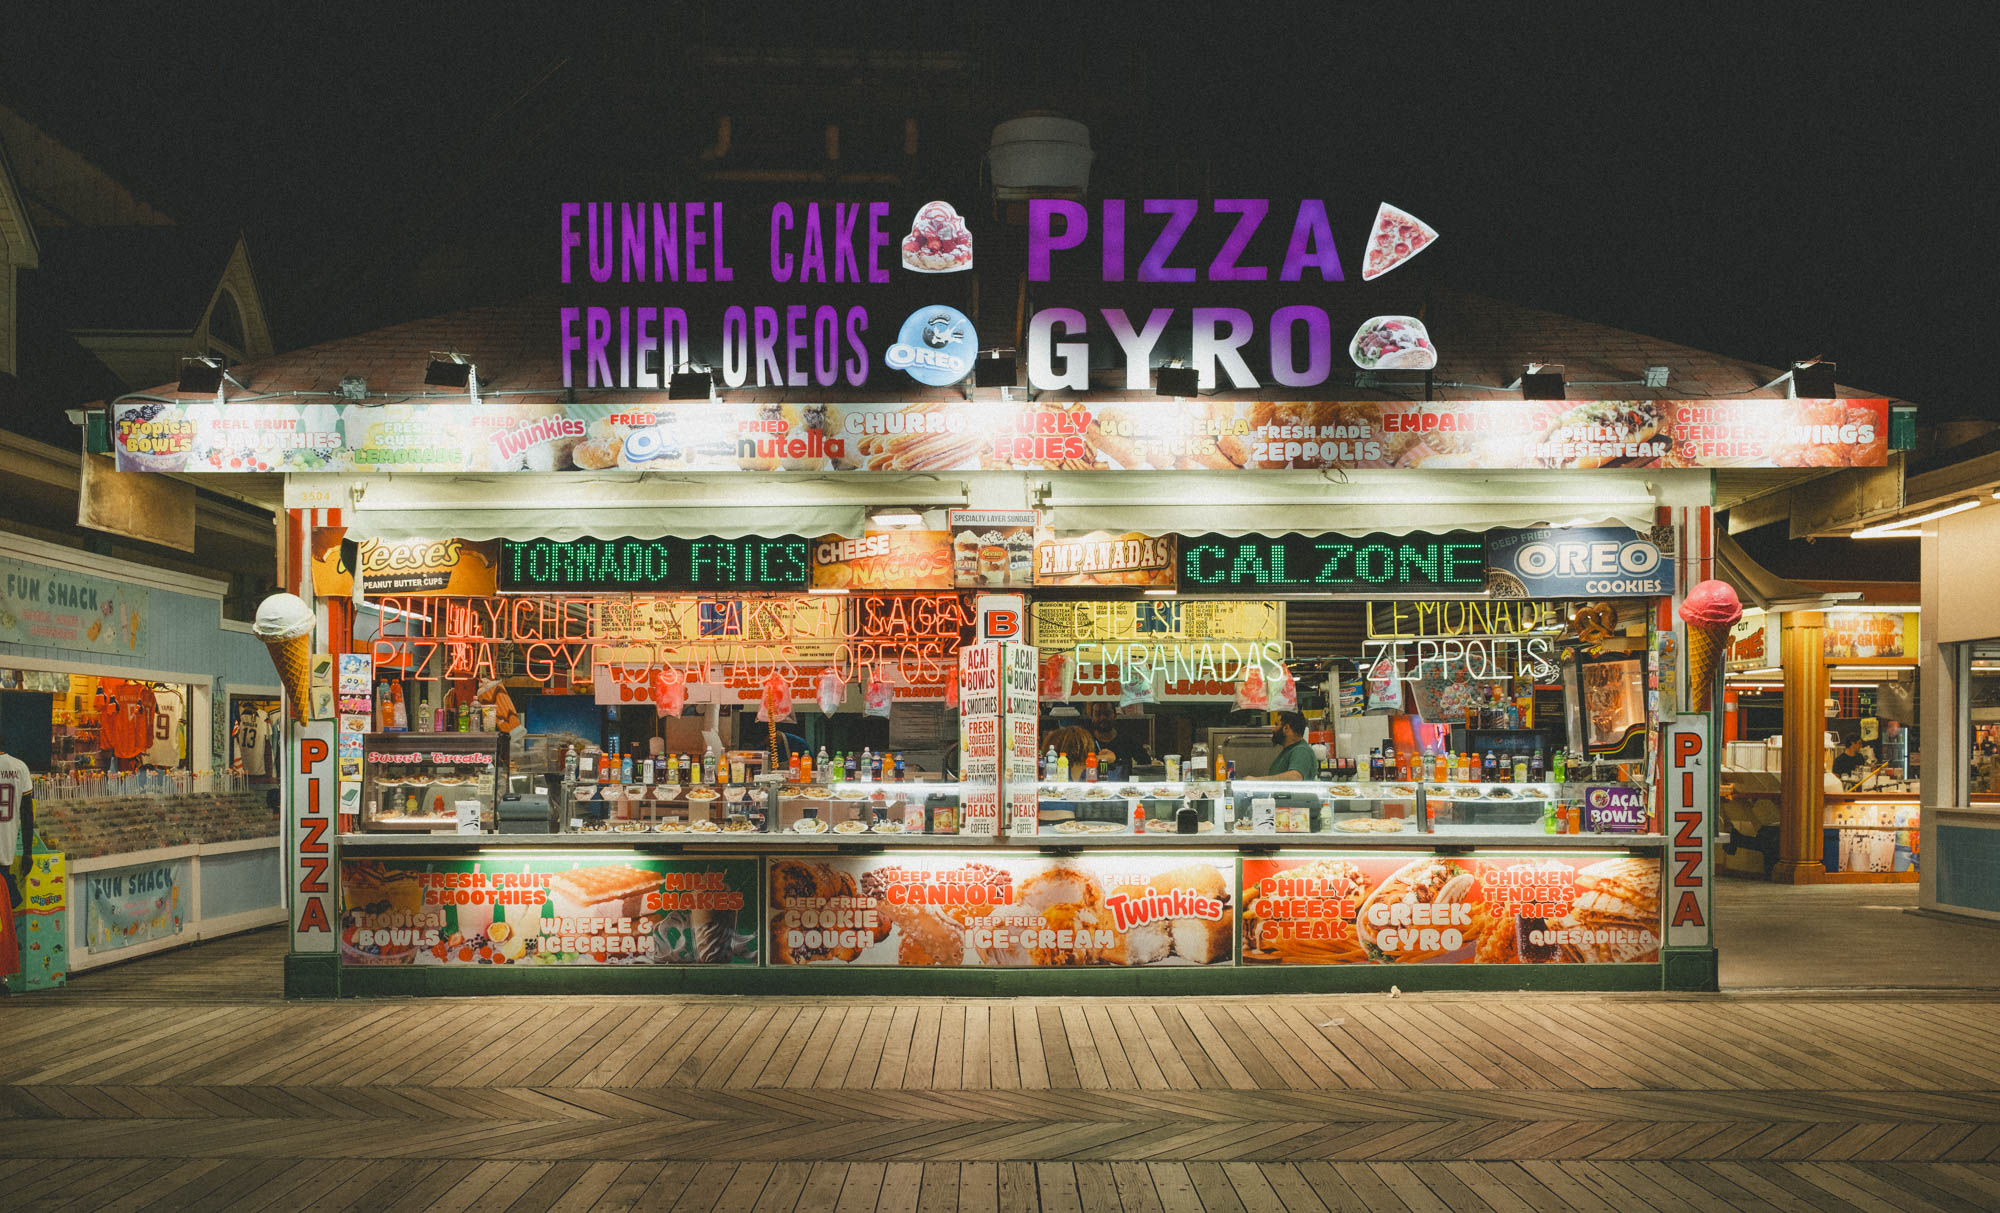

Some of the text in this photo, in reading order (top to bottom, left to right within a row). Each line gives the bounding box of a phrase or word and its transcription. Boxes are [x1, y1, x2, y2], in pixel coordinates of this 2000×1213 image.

[560, 201, 890, 283] FUNNEL CAKE
[1028, 199, 1345, 283] PIZZA
[560, 305, 869, 388] FRIED OREOS
[1027, 305, 1331, 391] GYRO
[885, 344, 966, 374] OREO
[119, 420, 197, 438] Tropical
[212, 420, 297, 430] REAL FRUIT
[472, 416, 515, 427] FRIED
[610, 414, 657, 425] FRIED
[738, 420, 789, 432] FRIED
[1383, 413, 1548, 433] EMPANAAS
[490, 415, 585, 460] Twinkies
[1256, 425, 1372, 438] FRESH MADE
[1561, 425, 1628, 441] PHILLY
[126, 438, 192, 452] BOWLS
[738, 429, 845, 458] nutella
[993, 437, 1086, 459] FRIES
[1252, 442, 1382, 461] ZEPPOLIS
[1682, 442, 1764, 458] & FRIES
[954, 514, 985, 523] SPECIALTY
[816, 534, 890, 565] CHEESE
[1490, 530, 1552, 551] DEEP FRIED
[505, 543, 806, 582] TORNADO FRIES
[1039, 537, 1169, 575] EMPANADAS
[1186, 544, 1483, 583] CALZONE
[1514, 540, 1662, 577] OREO
[852, 551, 951, 585] NACHOS
[7, 574, 98, 611] FUN SHACK
[363, 576, 443, 589] PEANUT BUTTER CUPS
[1585, 579, 1662, 594] COOKIES
[1369, 601, 1562, 637] LEMONADE
[1737, 622, 1748, 631] CUT
[373, 641, 496, 681] PIZZA
[527, 642, 651, 684] GYRO
[967, 648, 989, 669] ACAI
[1014, 649, 1033, 671] ACAI
[967, 669, 996, 691] BOWLS
[1014, 670, 1036, 693] BOWLS
[967, 696, 997, 716] SMOOTHIES
[968, 721, 994, 734] FRESH
[1014, 721, 1035, 735] FRESH
[241, 727, 257, 749] 13
[968, 734, 996, 746] SQUEEZED
[367, 752, 493, 764] Sweet Treats
[968, 745, 996, 758] LEMONADE
[967, 804, 996, 818] DEALS
[1013, 804, 1036, 818] DEALS
[1590, 810, 1646, 823] BOWLS
[297, 738, 332, 932] PIZZA
[970, 823, 990, 834] COFFEE
[1671, 732, 1705, 927] PIZZA
[94, 867, 173, 900] FUN SHACK
[418, 872, 552, 888] FRESH FRUIT
[665, 872, 724, 891] MILK
[888, 870, 984, 883] DEEP FRIED
[1103, 874, 1151, 886] FRIED
[1484, 870, 1575, 887] CHICKEN
[425, 889, 547, 906] SMOOTHIES
[887, 884, 1014, 906] CANNOLI
[1260, 878, 1351, 898] PHILLY
[1483, 886, 1575, 902] TENDERS
[646, 891, 744, 911] SHAKES
[785, 897, 877, 910] DEEP FRIED
[1254, 899, 1356, 919] CHEESE
[1490, 903, 1568, 918] & FRIES
[351, 909, 447, 929] Tropical
[785, 910, 879, 928] COOKIE
[964, 916, 1047, 927] DEEP FRIED
[1106, 889, 1224, 934] Twinkies
[1368, 903, 1472, 926] GREEK
[540, 917, 654, 934] WAFFLE &
[1262, 920, 1348, 941] STEAK
[359, 929, 440, 947] BOWLS
[537, 936, 657, 953] ICECREAM
[787, 929, 875, 949] DOUGH
[964, 929, 1115, 950] ICE-CREAM
[1376, 927, 1463, 952] GYRO
[1529, 929, 1653, 947] QUESADILLA
